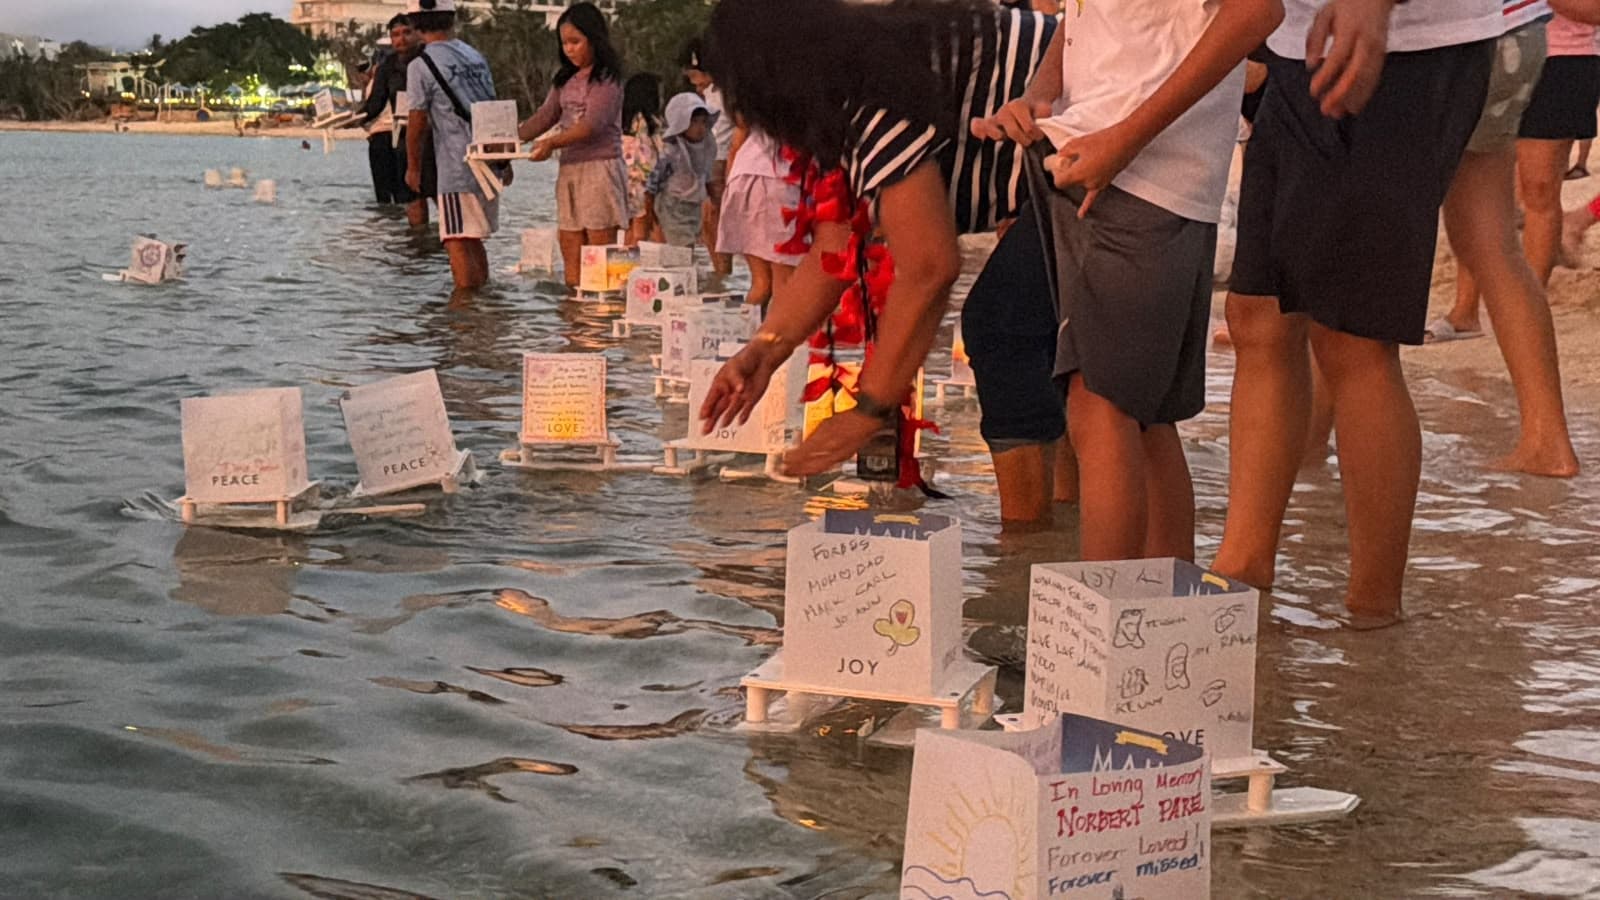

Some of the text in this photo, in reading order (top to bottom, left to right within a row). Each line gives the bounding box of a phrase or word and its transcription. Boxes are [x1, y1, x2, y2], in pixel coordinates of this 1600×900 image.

[547, 423, 579, 433] LOVE
[715, 430, 737, 439] JOY
[383, 458, 426, 475] PEACE
[212, 474, 259, 487] PEACE
[856, 555, 885, 577] DAD
[837, 657, 880, 675] JOY
[1048, 781, 1079, 802] In
[1092, 776, 1144, 804] Loving
[1056, 803, 1145, 838] NORBERT
[1047, 845, 1126, 872] Forever
[1048, 869, 1119, 897] Forever
